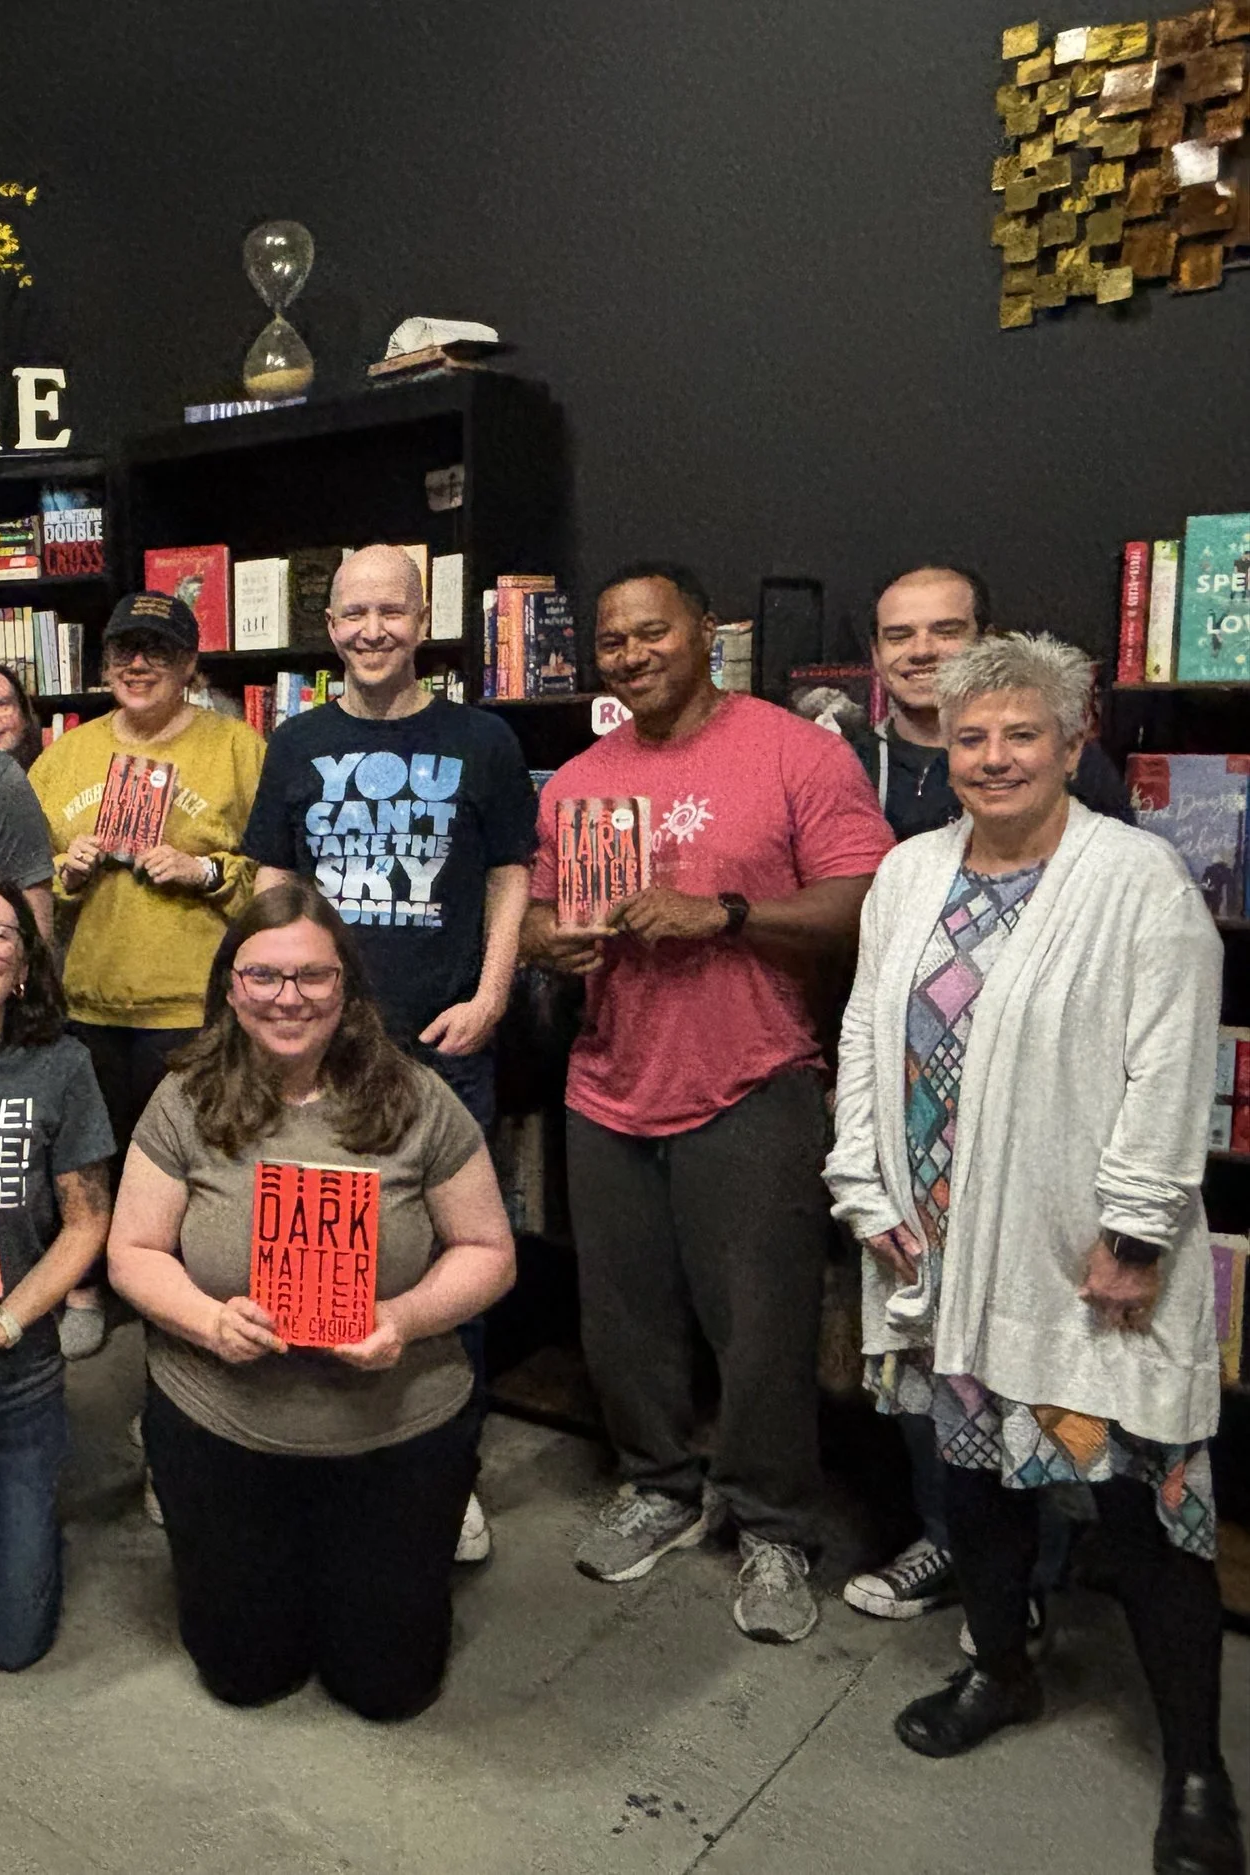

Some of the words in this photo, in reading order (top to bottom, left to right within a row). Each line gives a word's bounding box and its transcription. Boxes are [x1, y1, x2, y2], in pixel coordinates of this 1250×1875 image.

[44, 521, 104, 544] DOUBLE
[44, 543, 105, 575] CROSS
[311, 751, 463, 802] YOU
[305, 800, 457, 836] CAN'T
[306, 834, 387, 857] TAKE
[392, 834, 453, 858] THE
[315, 855, 447, 902] SKY
[395, 901, 443, 927] ME
[259, 1191, 370, 1251] DARK
[258, 1245, 370, 1288] MATTER
